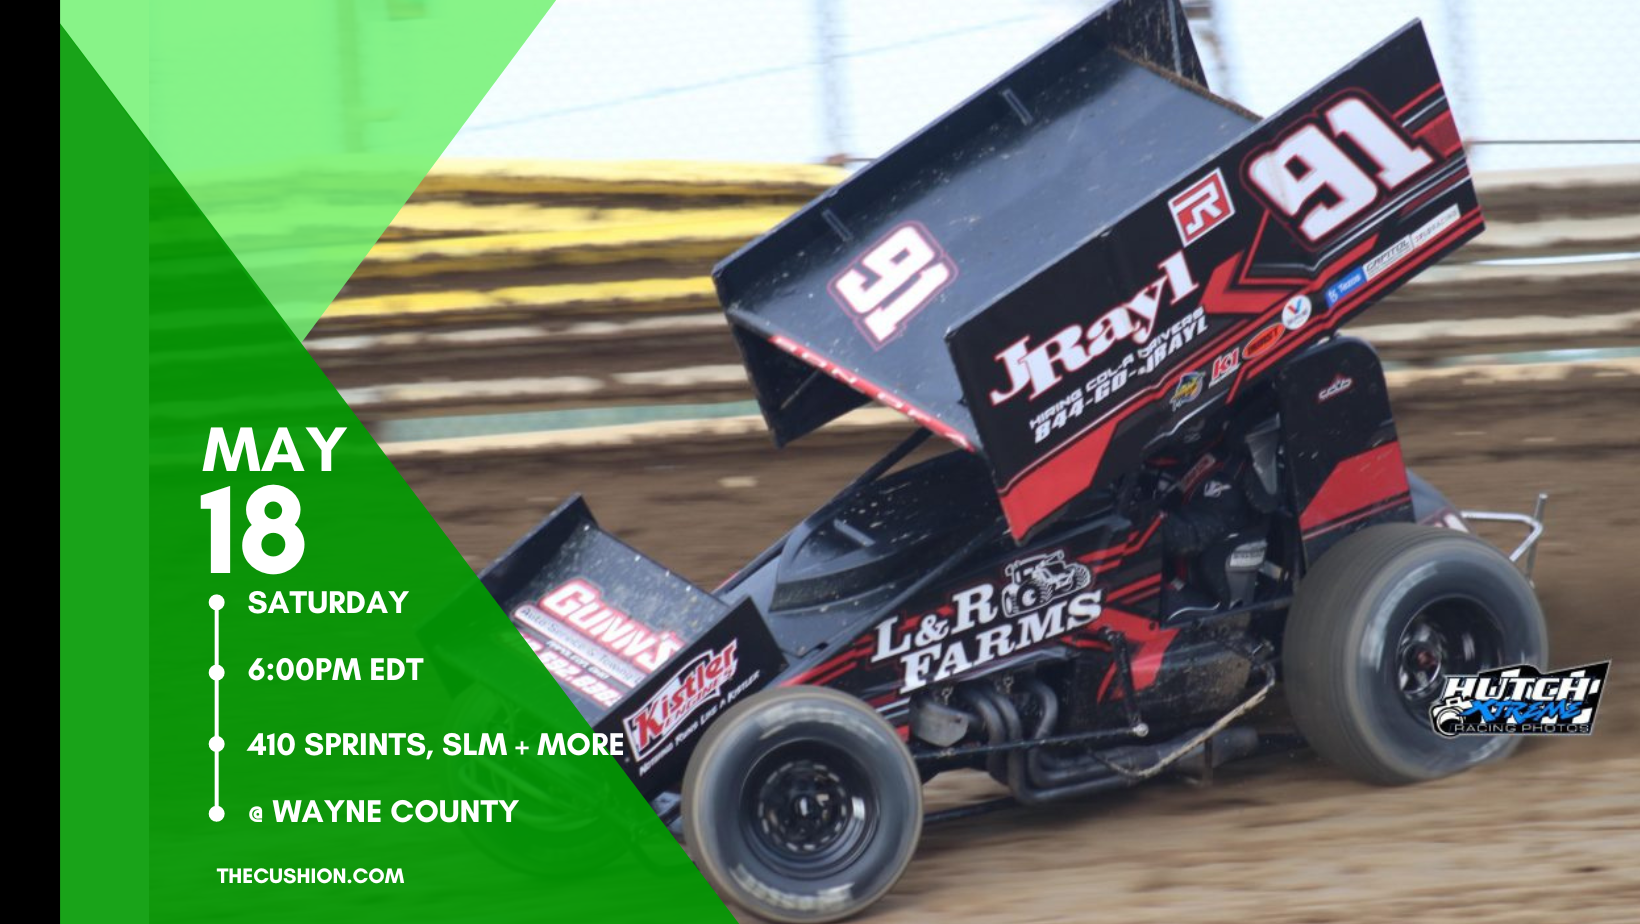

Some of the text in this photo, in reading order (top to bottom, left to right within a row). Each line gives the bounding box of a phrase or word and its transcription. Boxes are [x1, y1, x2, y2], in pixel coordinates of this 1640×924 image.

[1248, 97, 1434, 242] 91
[836, 226, 949, 343] 91
[989, 250, 1199, 405] JRayl
[1029, 388, 1083, 430] HIRING
[871, 583, 998, 663] L&R
[900, 588, 1103, 694] FARMS
[633, 643, 737, 749] Kistler
